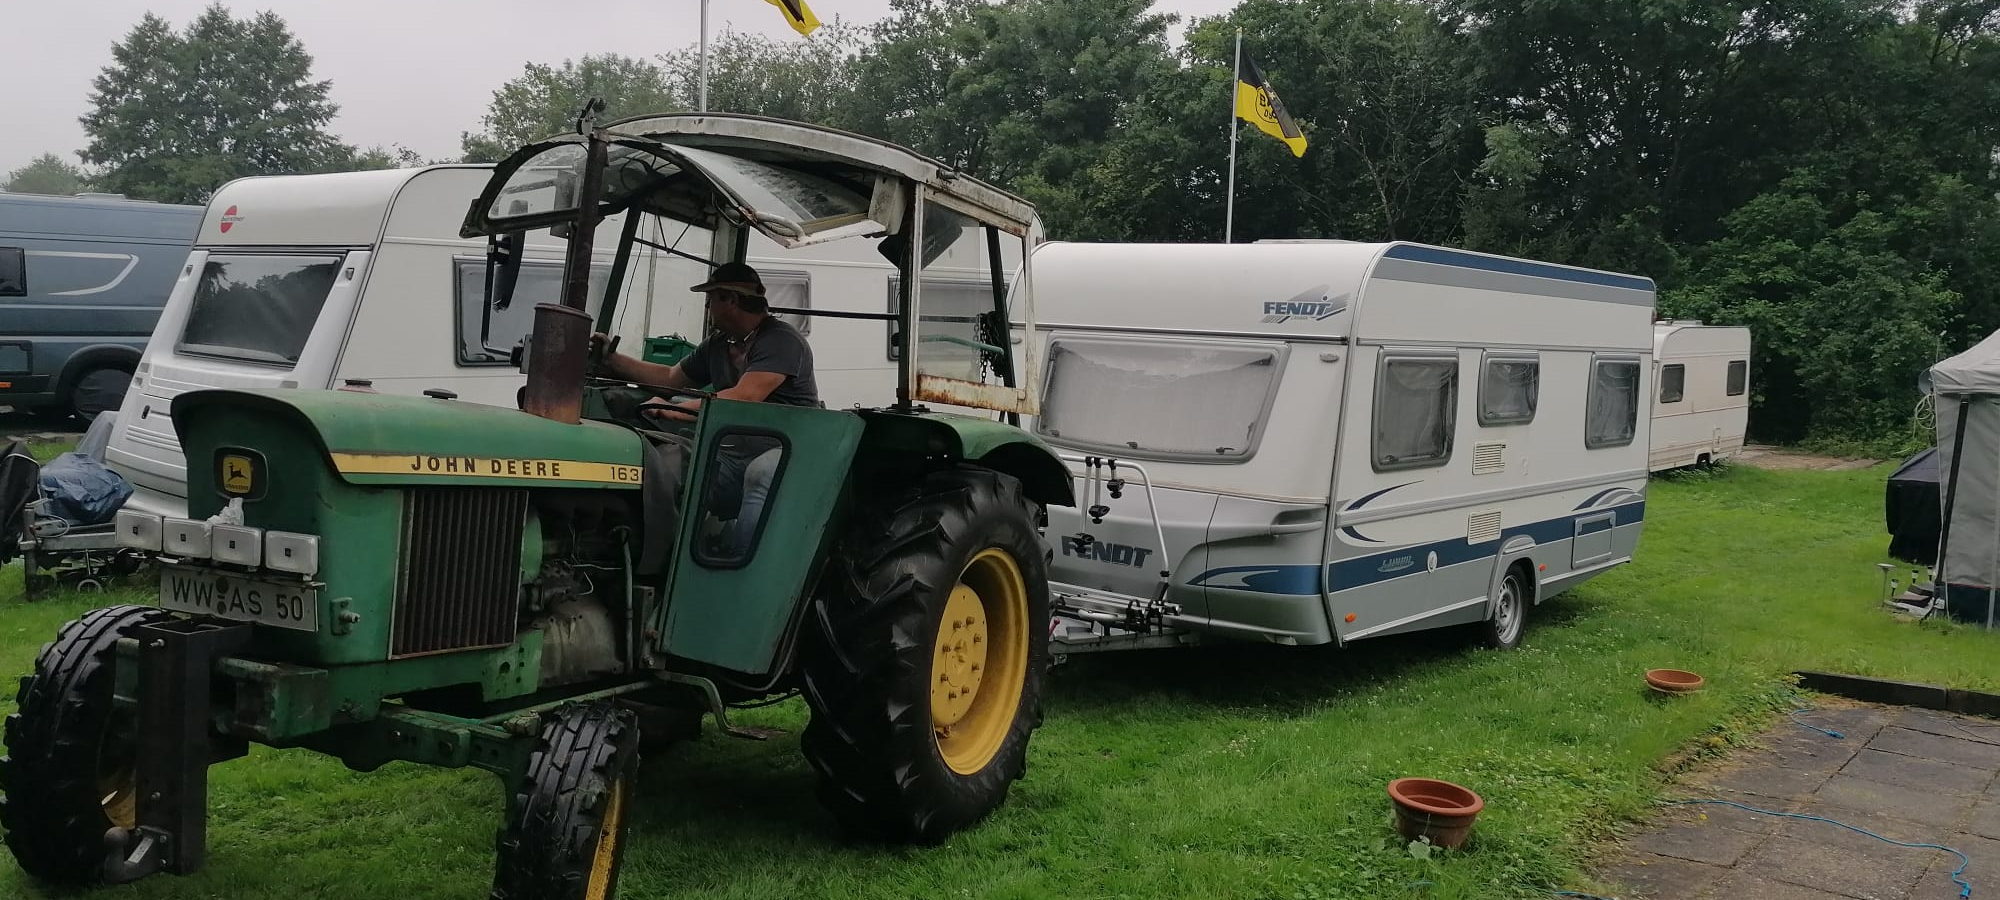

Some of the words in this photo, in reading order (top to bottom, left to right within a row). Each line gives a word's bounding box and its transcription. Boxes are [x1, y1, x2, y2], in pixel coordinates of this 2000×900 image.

[1263, 302, 1331, 316] FENDT
[411, 456, 475, 473] JOHN
[491, 459, 560, 476] DEERE
[611, 466, 645, 482] 163
[276, 594, 304, 621] 50
